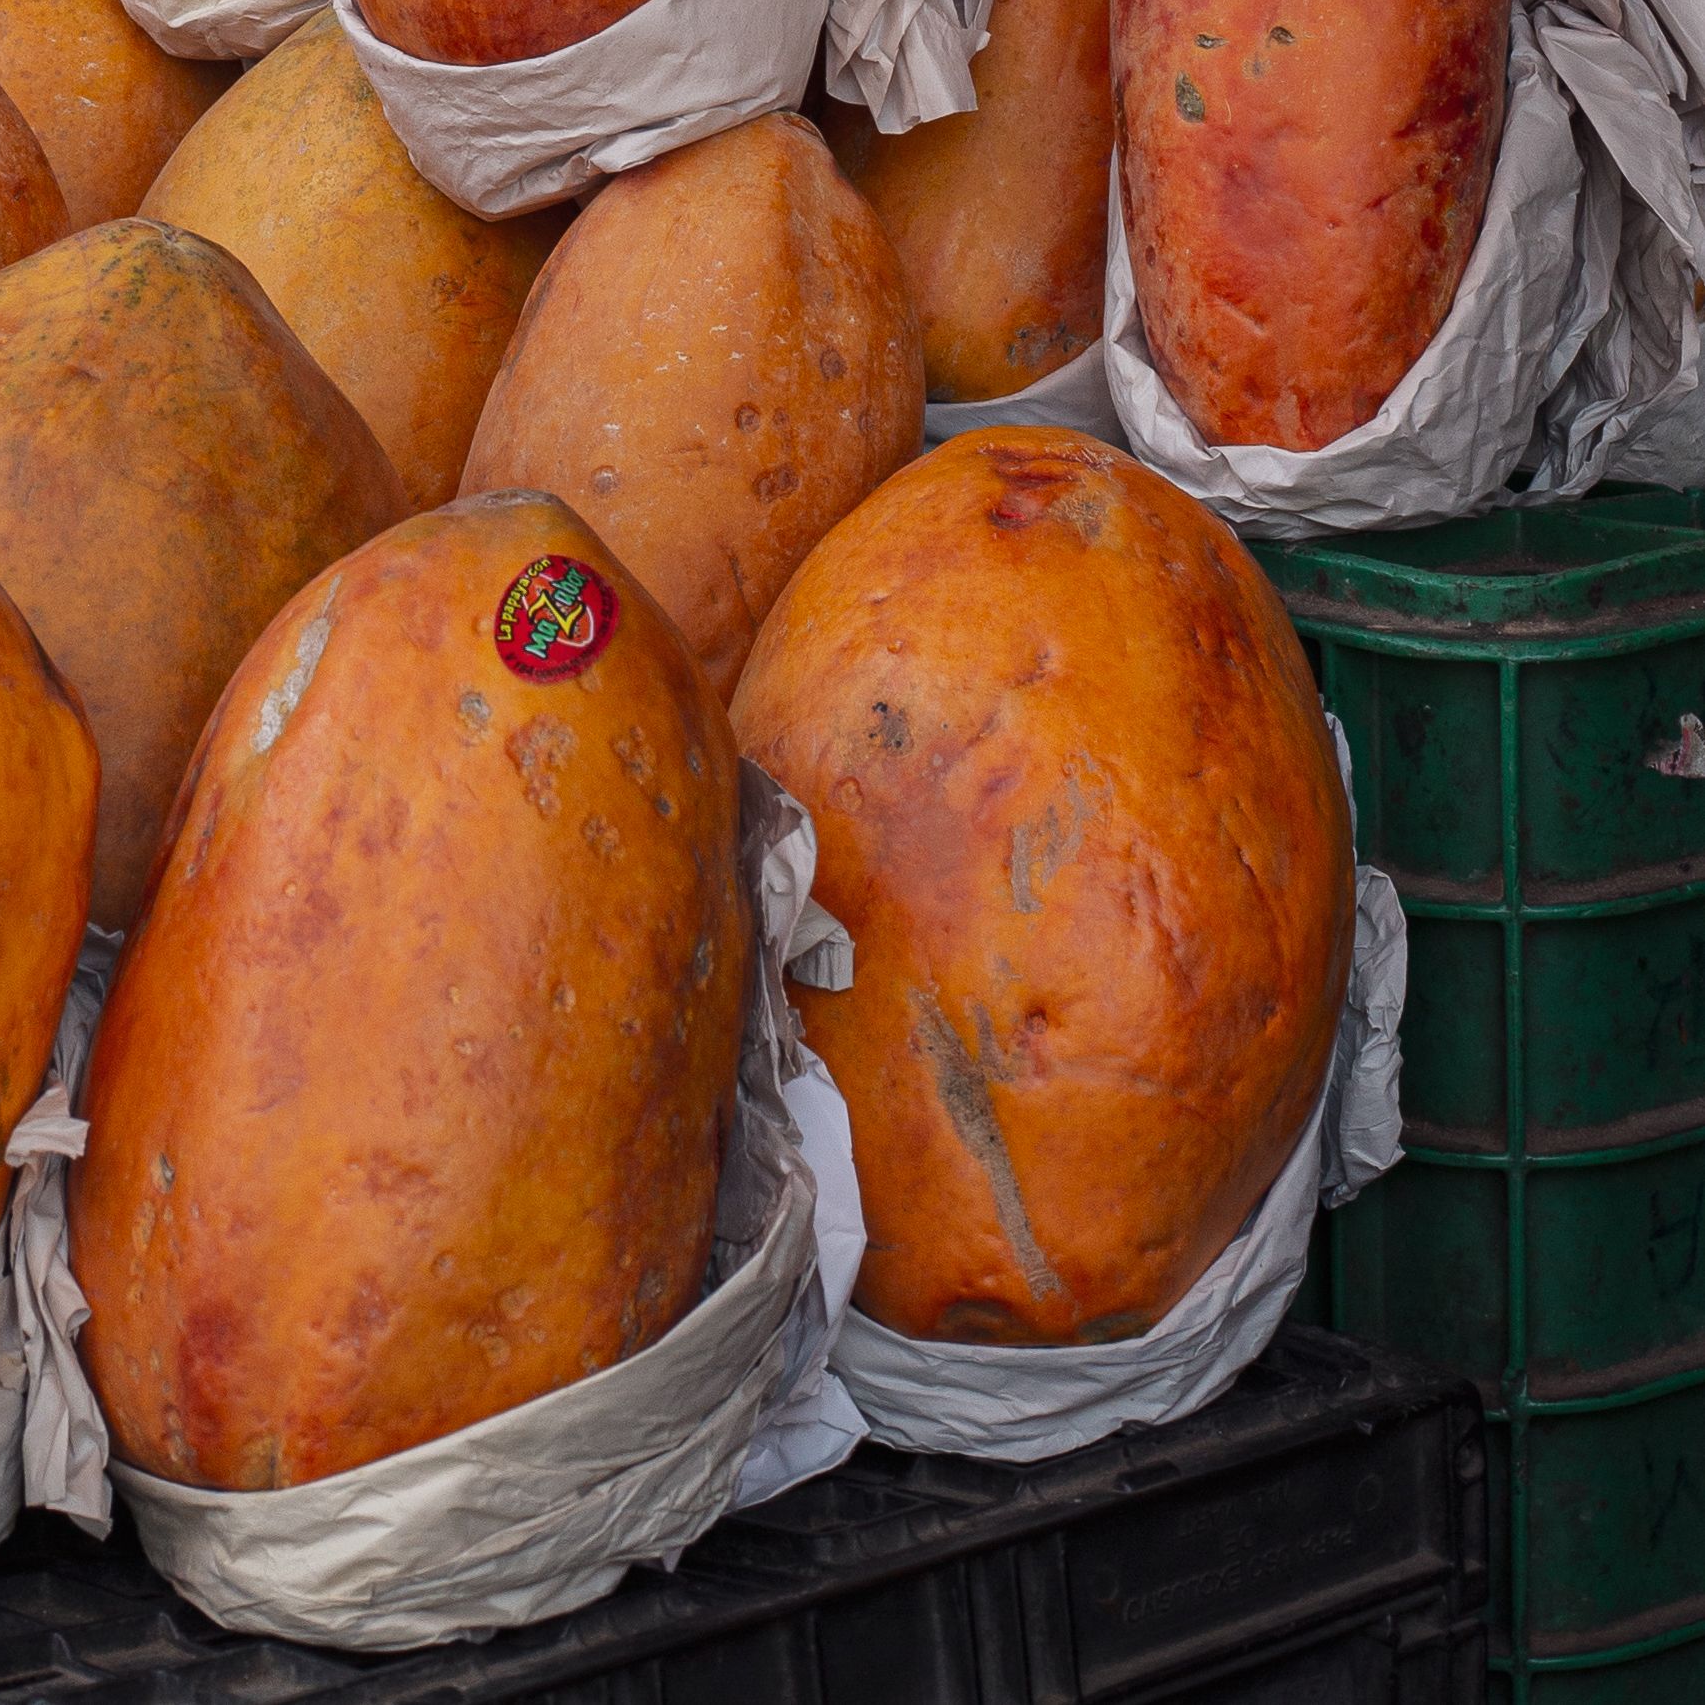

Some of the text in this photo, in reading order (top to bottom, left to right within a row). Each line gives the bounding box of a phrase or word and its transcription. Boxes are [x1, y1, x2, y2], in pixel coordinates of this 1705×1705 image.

[497, 557, 552, 641] La papaya con
